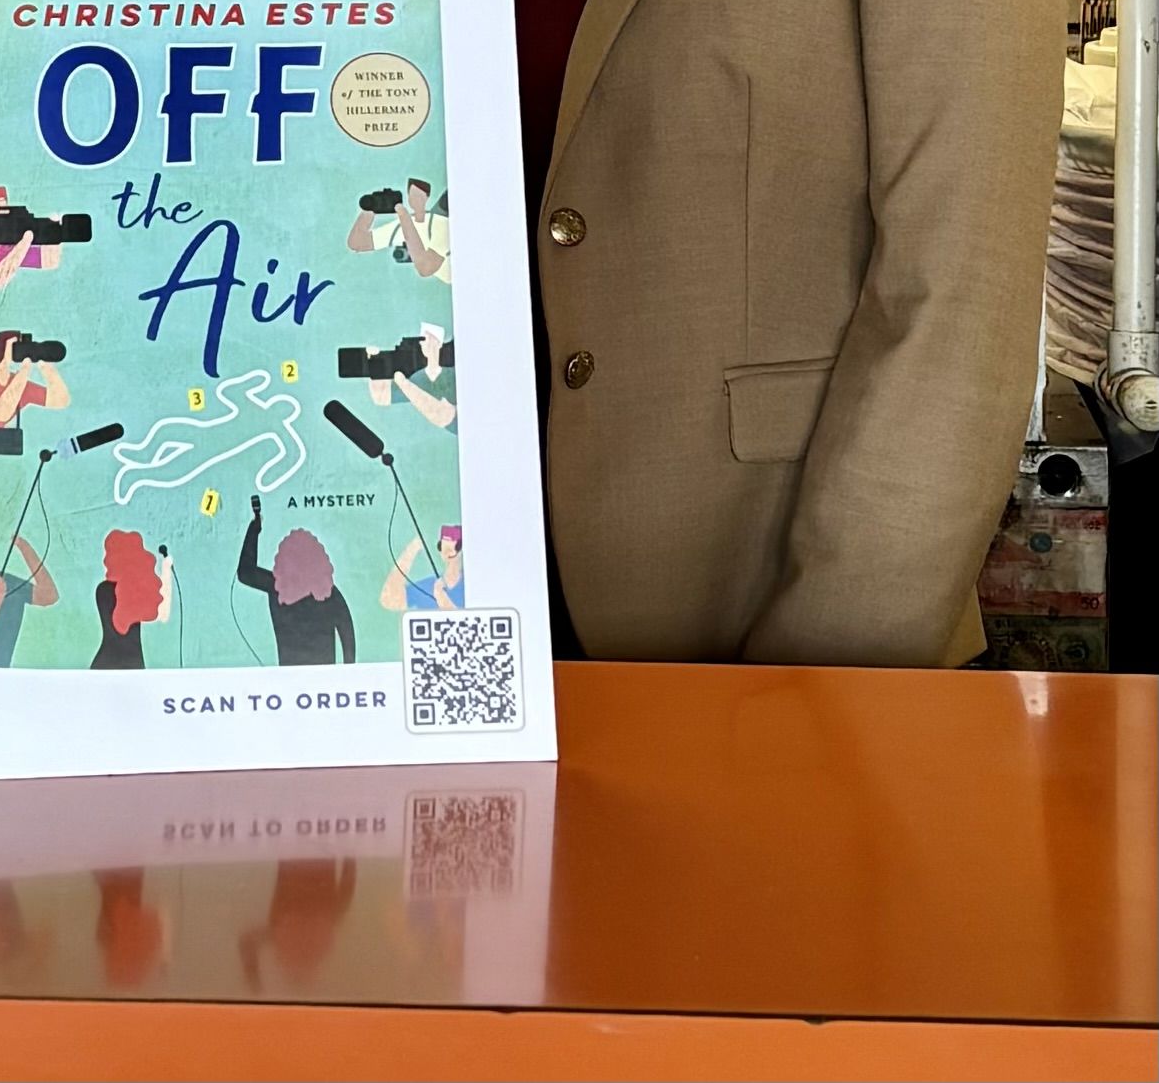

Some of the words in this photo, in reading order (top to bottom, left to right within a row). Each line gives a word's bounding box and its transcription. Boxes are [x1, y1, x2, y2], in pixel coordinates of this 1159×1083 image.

[13, 4, 246, 27] CHRISTINA
[266, 3, 396, 25] ESTES
[355, 72, 405, 81] WINNER
[358, 89, 383, 98] THE
[386, 88, 419, 98] TONY
[37, 44, 324, 166] OFF
[346, 105, 416, 115] HILLERMAN
[365, 122, 400, 132] PRIZE
[111, 173, 204, 230] the
[138, 220, 336, 379] Air
[286, 364, 295, 377] 2
[193, 391, 202, 405] 3
[287, 497, 298, 508] A
[304, 494, 376, 507] MYSTERY
[163, 696, 235, 714] SCAN
[248, 694, 282, 711] TO
[296, 691, 387, 709] ORDER
